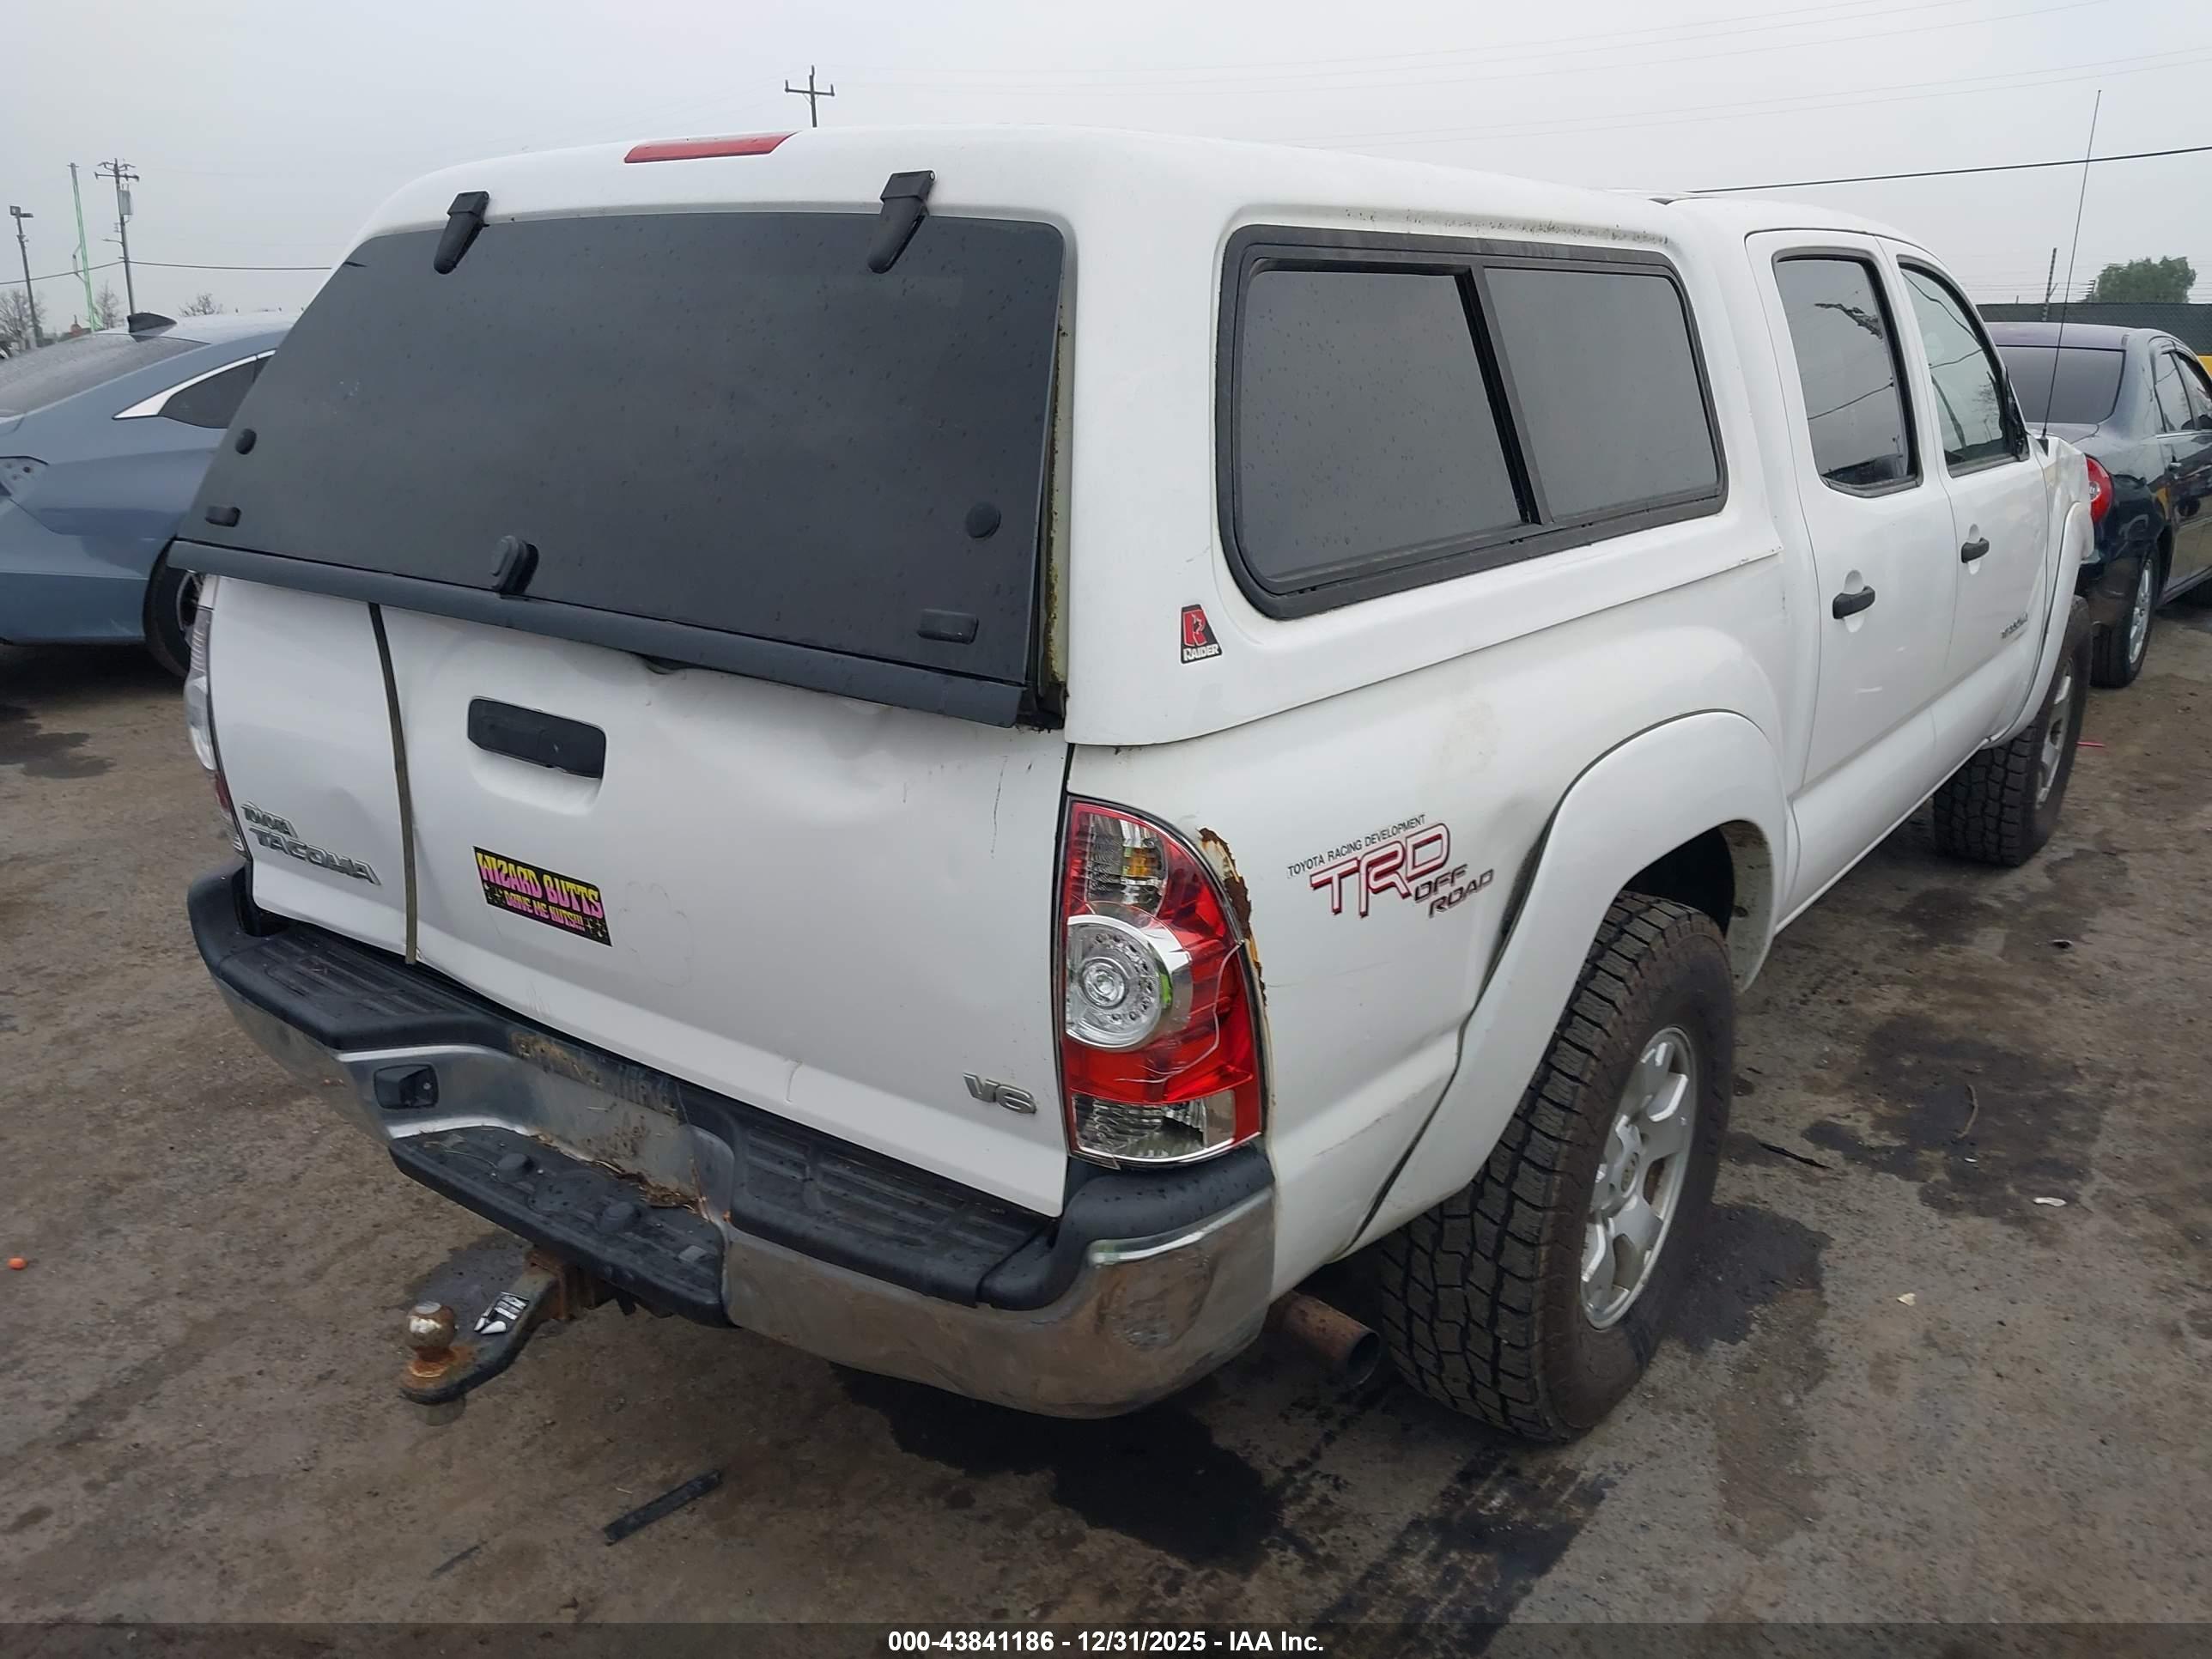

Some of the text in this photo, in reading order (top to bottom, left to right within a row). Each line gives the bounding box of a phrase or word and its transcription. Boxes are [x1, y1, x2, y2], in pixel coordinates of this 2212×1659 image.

[1183, 644, 1218, 661] RAIDER
[249, 825, 381, 886] TACOMA
[1288, 814, 1426, 877] TOYOTA RACING DEVELOPMENT
[1310, 823, 1450, 918] TRD
[477, 852, 603, 919] WIZARD BUTTS
[1414, 863, 1468, 902] OFF
[1428, 868, 1495, 918] ROAD
[532, 899, 550, 920] ME
[963, 1072, 1037, 1115] V6
